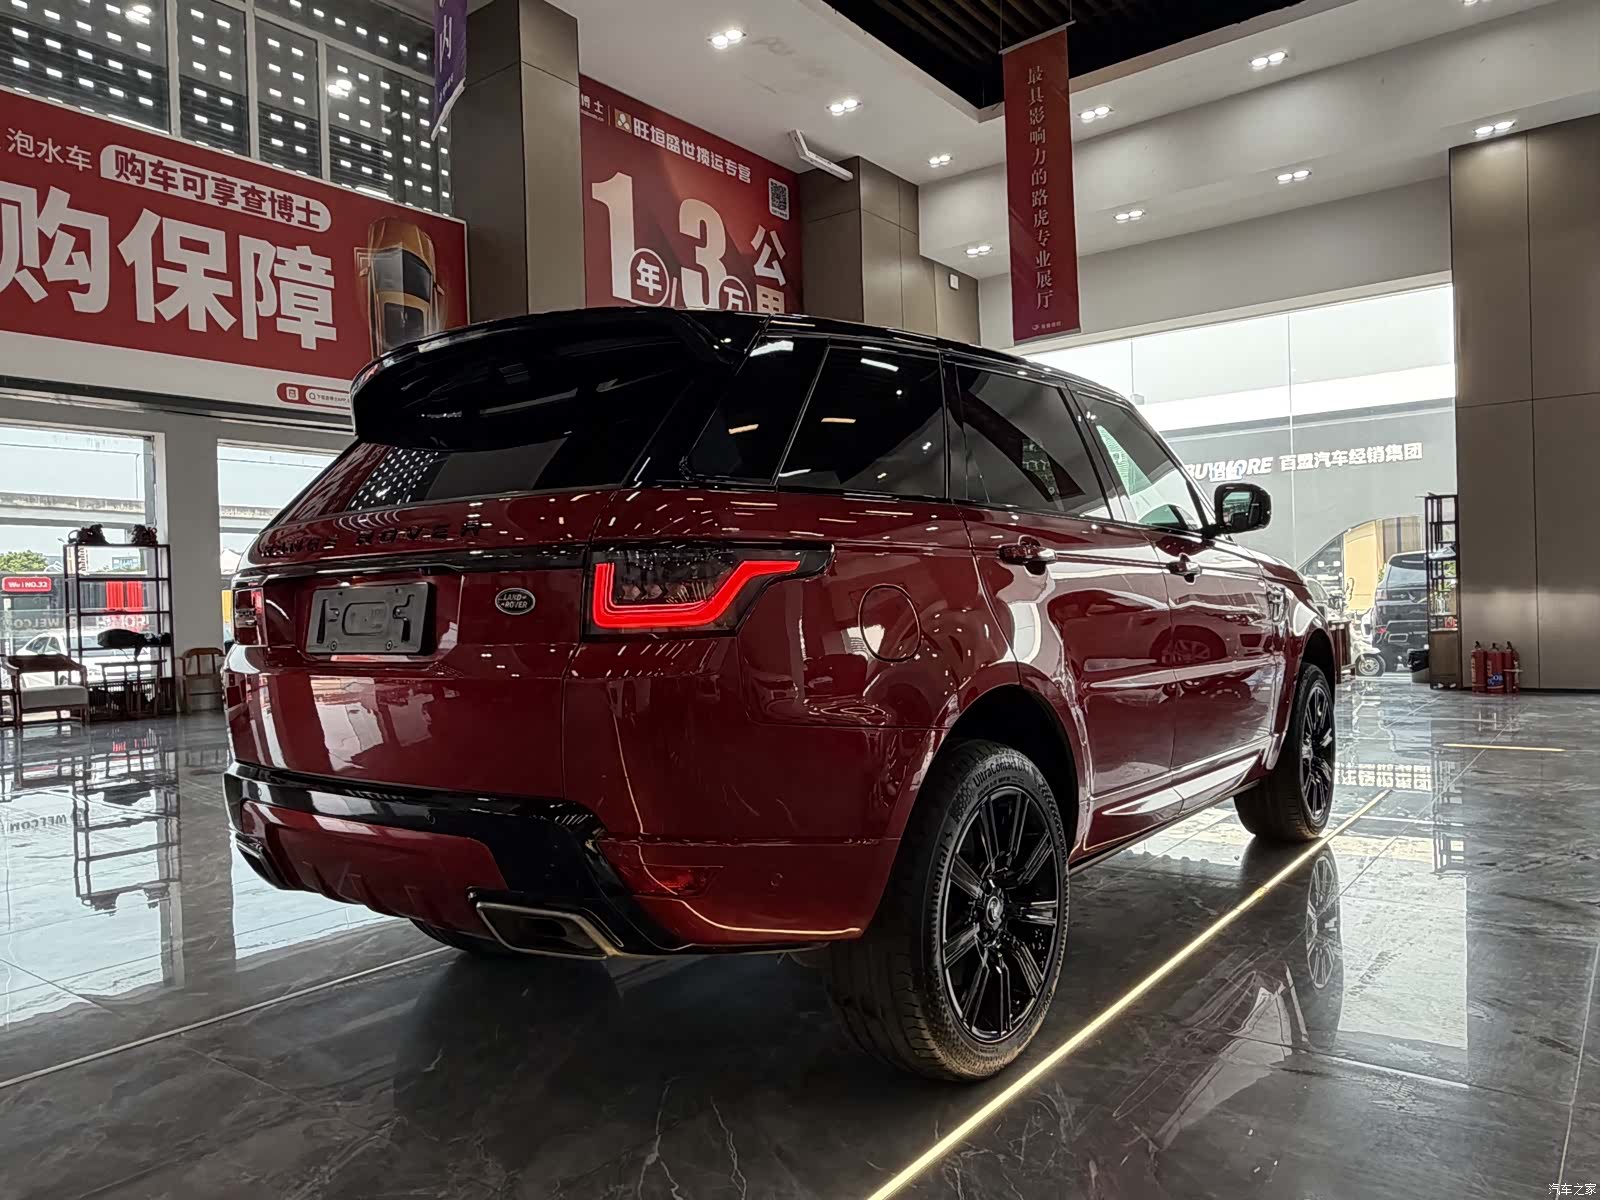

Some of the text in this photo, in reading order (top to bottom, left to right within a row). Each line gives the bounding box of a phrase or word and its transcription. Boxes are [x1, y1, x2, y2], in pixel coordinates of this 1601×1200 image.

[5, 128, 93, 172] 泡水车
[114, 149, 321, 230] 购车可享查博士
[1026, 65, 1054, 310] 最具影响力的路虎专业展厅
[0, 180, 337, 350] 购保障
[1279, 443, 1423, 472] 百盟汽车经销集团
[503, 593, 522, 601] LAND
[504, 601, 528, 609] ROVER
